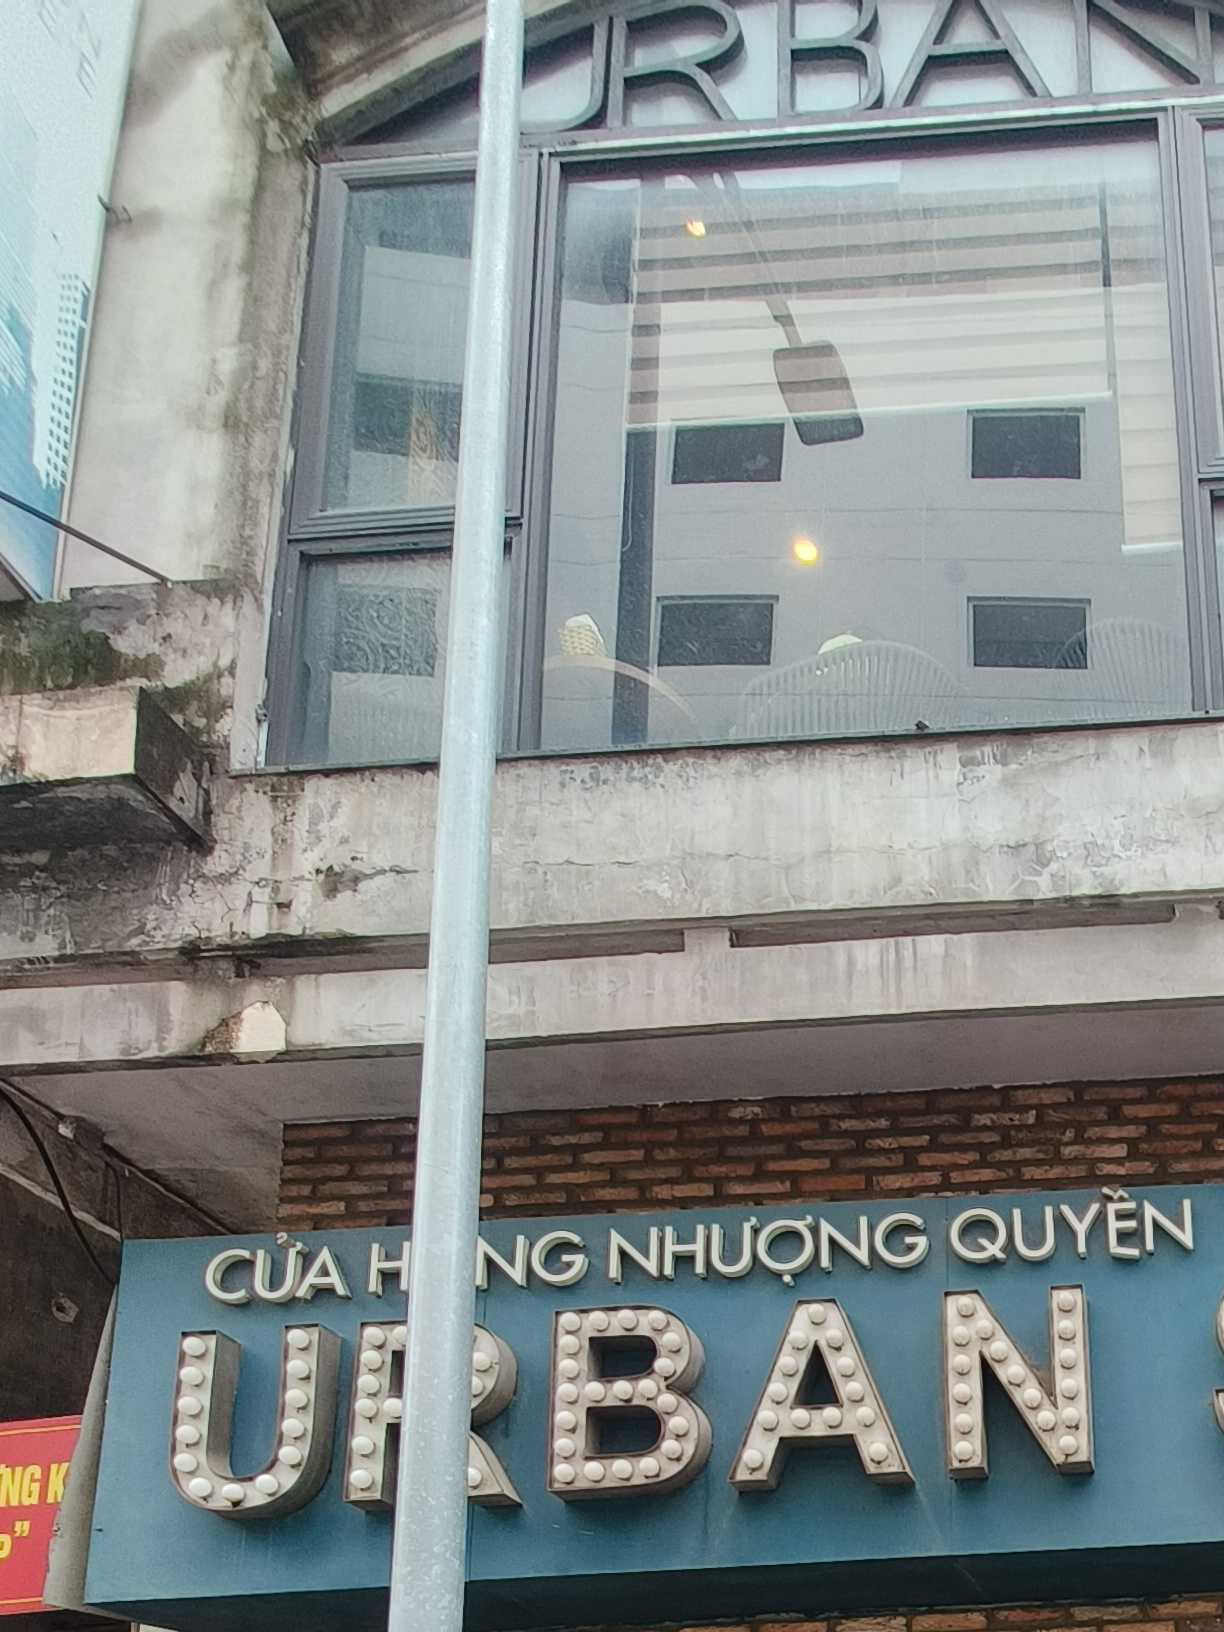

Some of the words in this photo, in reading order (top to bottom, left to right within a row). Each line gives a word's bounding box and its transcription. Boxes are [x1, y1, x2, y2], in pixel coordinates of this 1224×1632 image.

[205, 1231, 353, 1305] CỬA
[367, 1230, 591, 1298] HNG
[608, 1211, 931, 1287] NHƯỢNG
[949, 1187, 1195, 1262] QUYỀN
[0, 1463, 42, 1508] NG
